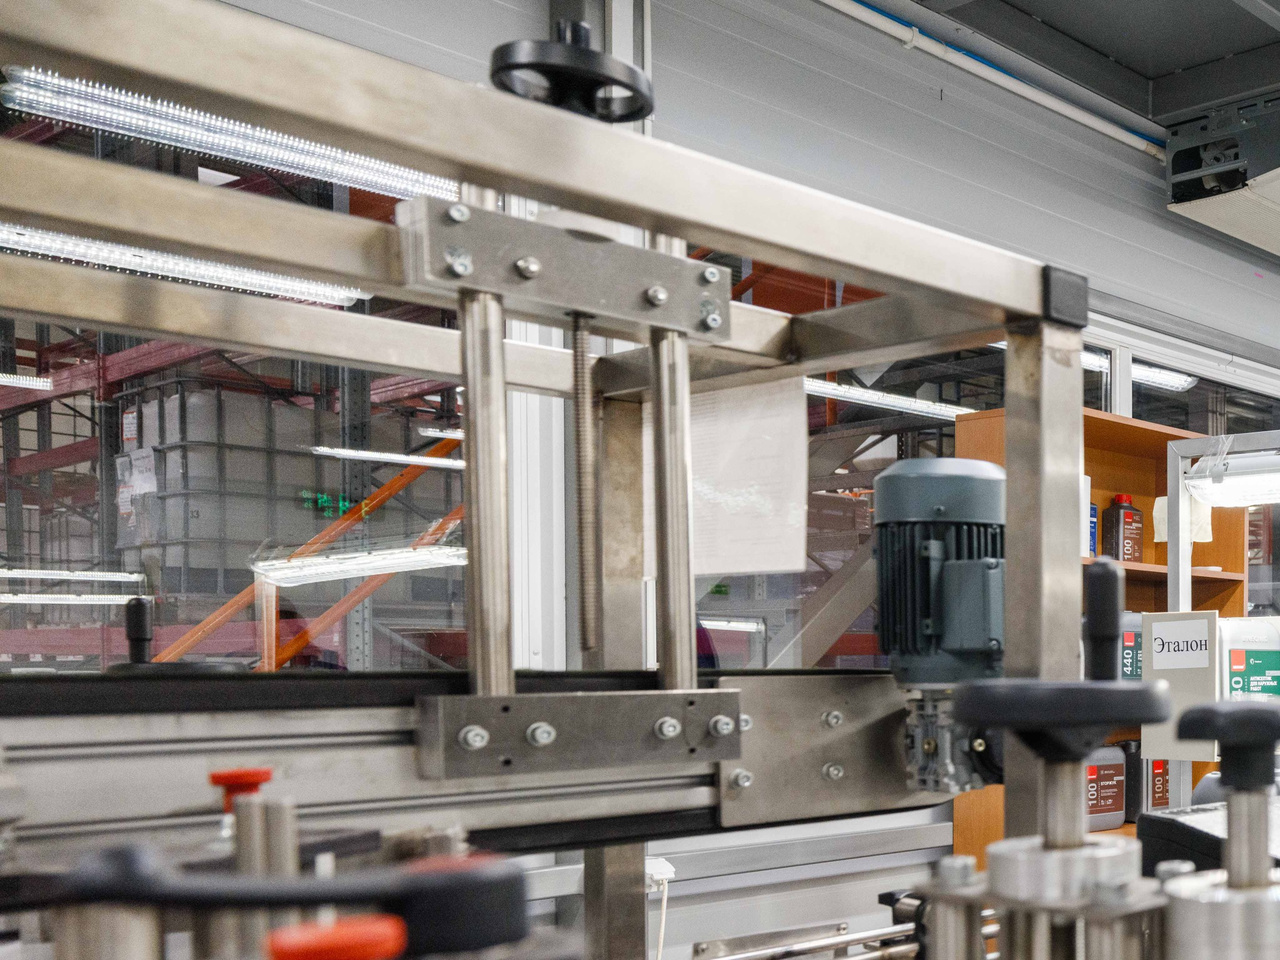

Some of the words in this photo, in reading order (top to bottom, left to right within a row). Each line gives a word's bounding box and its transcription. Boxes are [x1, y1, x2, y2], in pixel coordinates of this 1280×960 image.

[1124, 540, 1132, 559] 100
[1153, 636, 1209, 654] Эталон
[1123, 649, 1133, 675] 440
[1088, 783, 1097, 806] 100
[1155, 777, 1163, 799] 100
